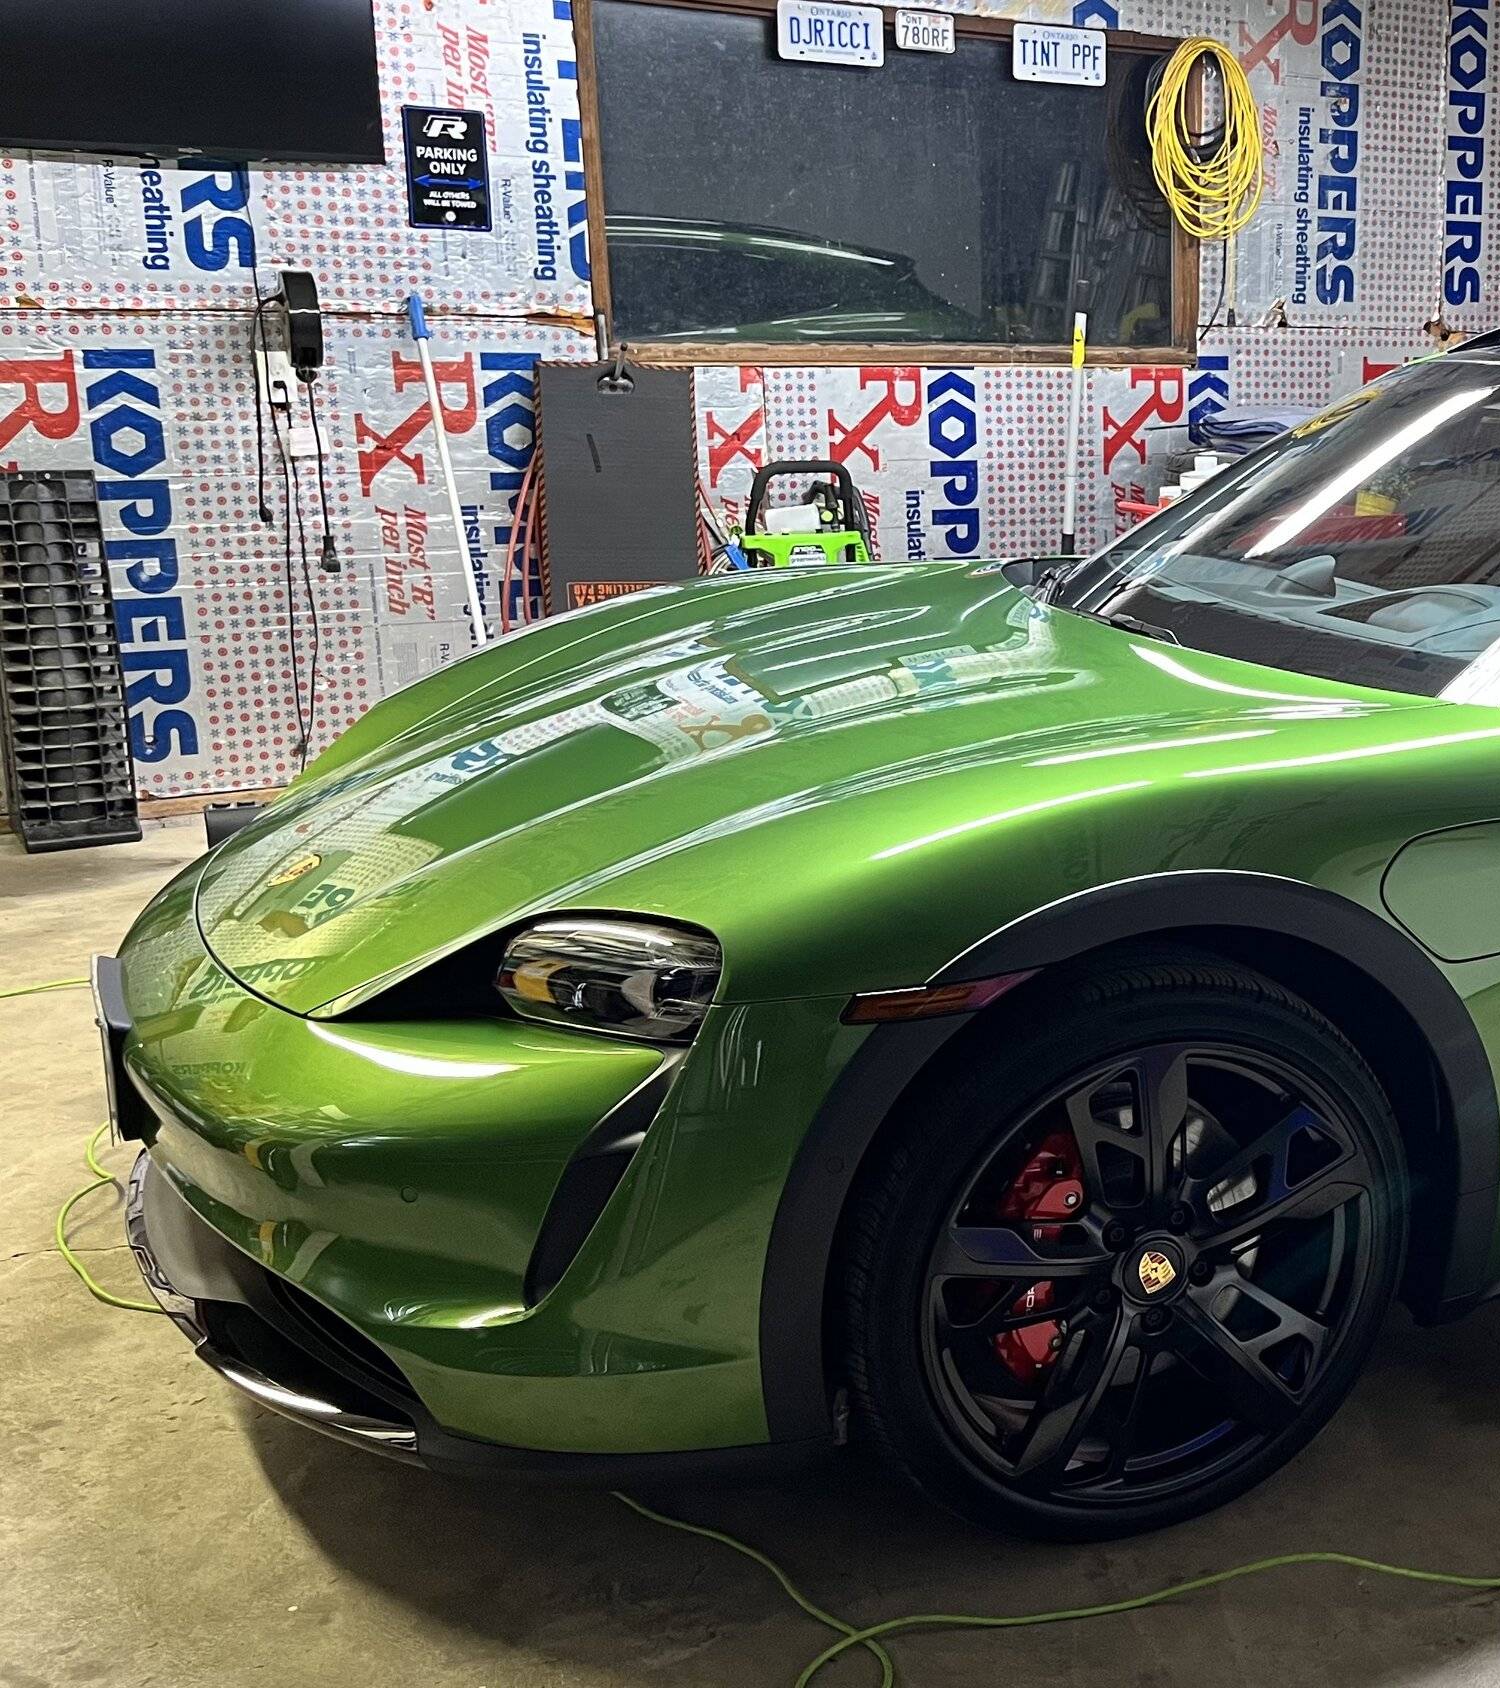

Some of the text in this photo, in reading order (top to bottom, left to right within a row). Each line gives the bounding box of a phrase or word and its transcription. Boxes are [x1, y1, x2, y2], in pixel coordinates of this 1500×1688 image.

[789, 16, 870, 49] DJRICCI
[811, 7, 851, 17] ONTARIO
[902, 25, 949, 47] 780RF
[905, 16, 922, 25] ONT
[1042, 31, 1079, 41] ONTARIO
[436, 22, 462, 77] per
[465, 25, 492, 97] Most
[1020, 39, 1101, 71] TINT PPF
[416, 146, 478, 162] PARKING
[429, 161, 466, 175] ONLY
[522, 33, 561, 281] insulating sheathing
[1316, 0, 1361, 305] KOPPERS
[1444, 0, 1488, 306] KOPPERS
[139, 153, 176, 270] heathing
[422, 199, 440, 207] WILL
[451, 200, 477, 209] TOWED
[429, 191, 470, 200] ALL OTHERS
[1292, 107, 1314, 304] insulating sheathing
[927, 367, 980, 560] KOPP
[404, 504, 431, 571] Most
[904, 490, 926, 560] insulati
[83, 349, 199, 764] KOPPERS
[375, 505, 411, 615] per inch
